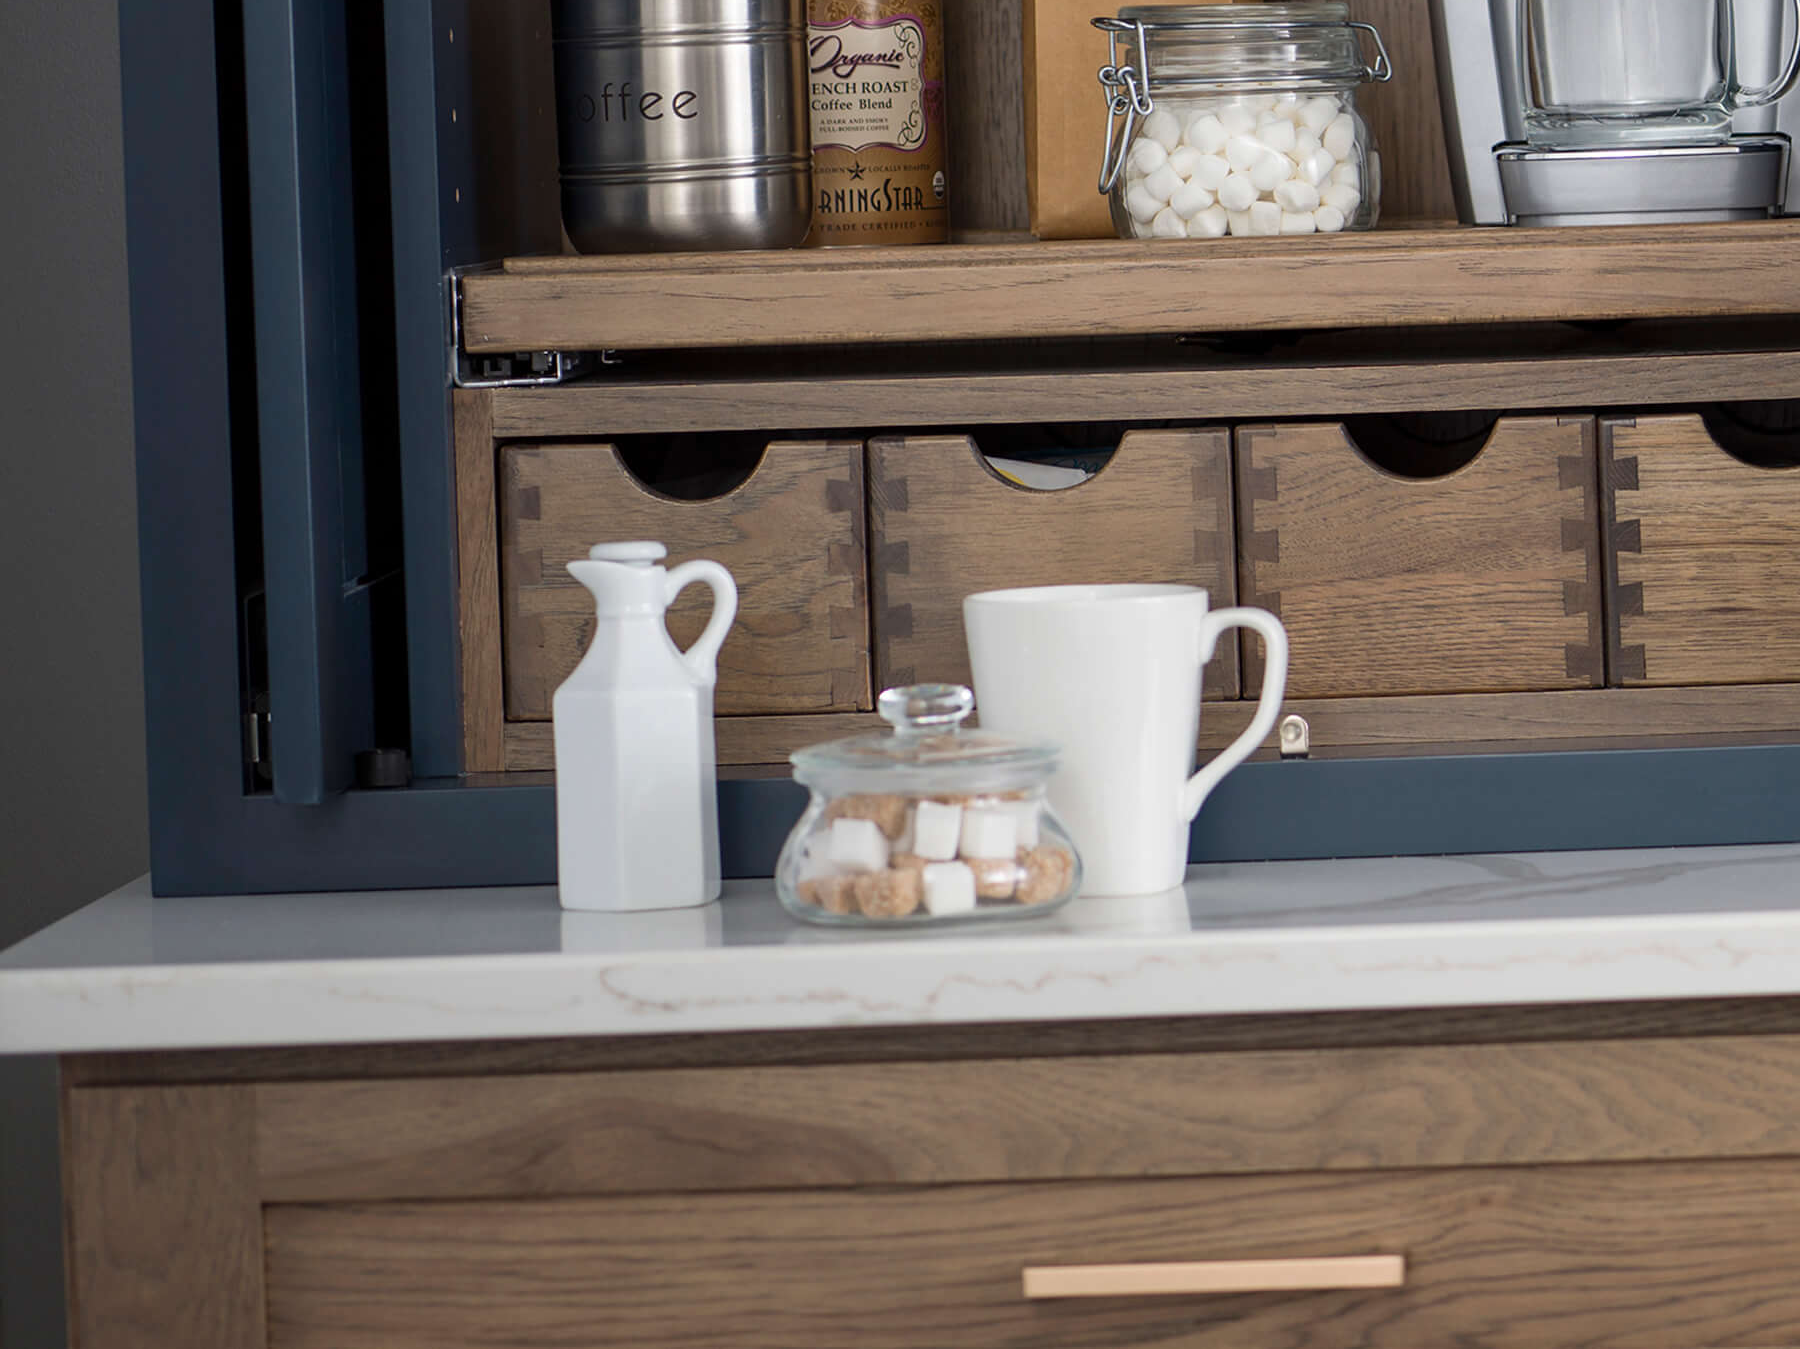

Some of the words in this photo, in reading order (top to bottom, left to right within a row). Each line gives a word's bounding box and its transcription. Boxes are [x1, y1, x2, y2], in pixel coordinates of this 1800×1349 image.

[809, 34, 905, 78] Organic
[811, 82, 857, 95] ENCH
[861, 81, 909, 93] ROAST
[576, 82, 698, 122] offee
[811, 99, 853, 111] Coffee
[859, 98, 893, 109] Blend
[818, 178, 932, 213] RNINGSTAR
[820, 223, 857, 231] TRADE
[861, 220, 917, 231] CERTIFIED
